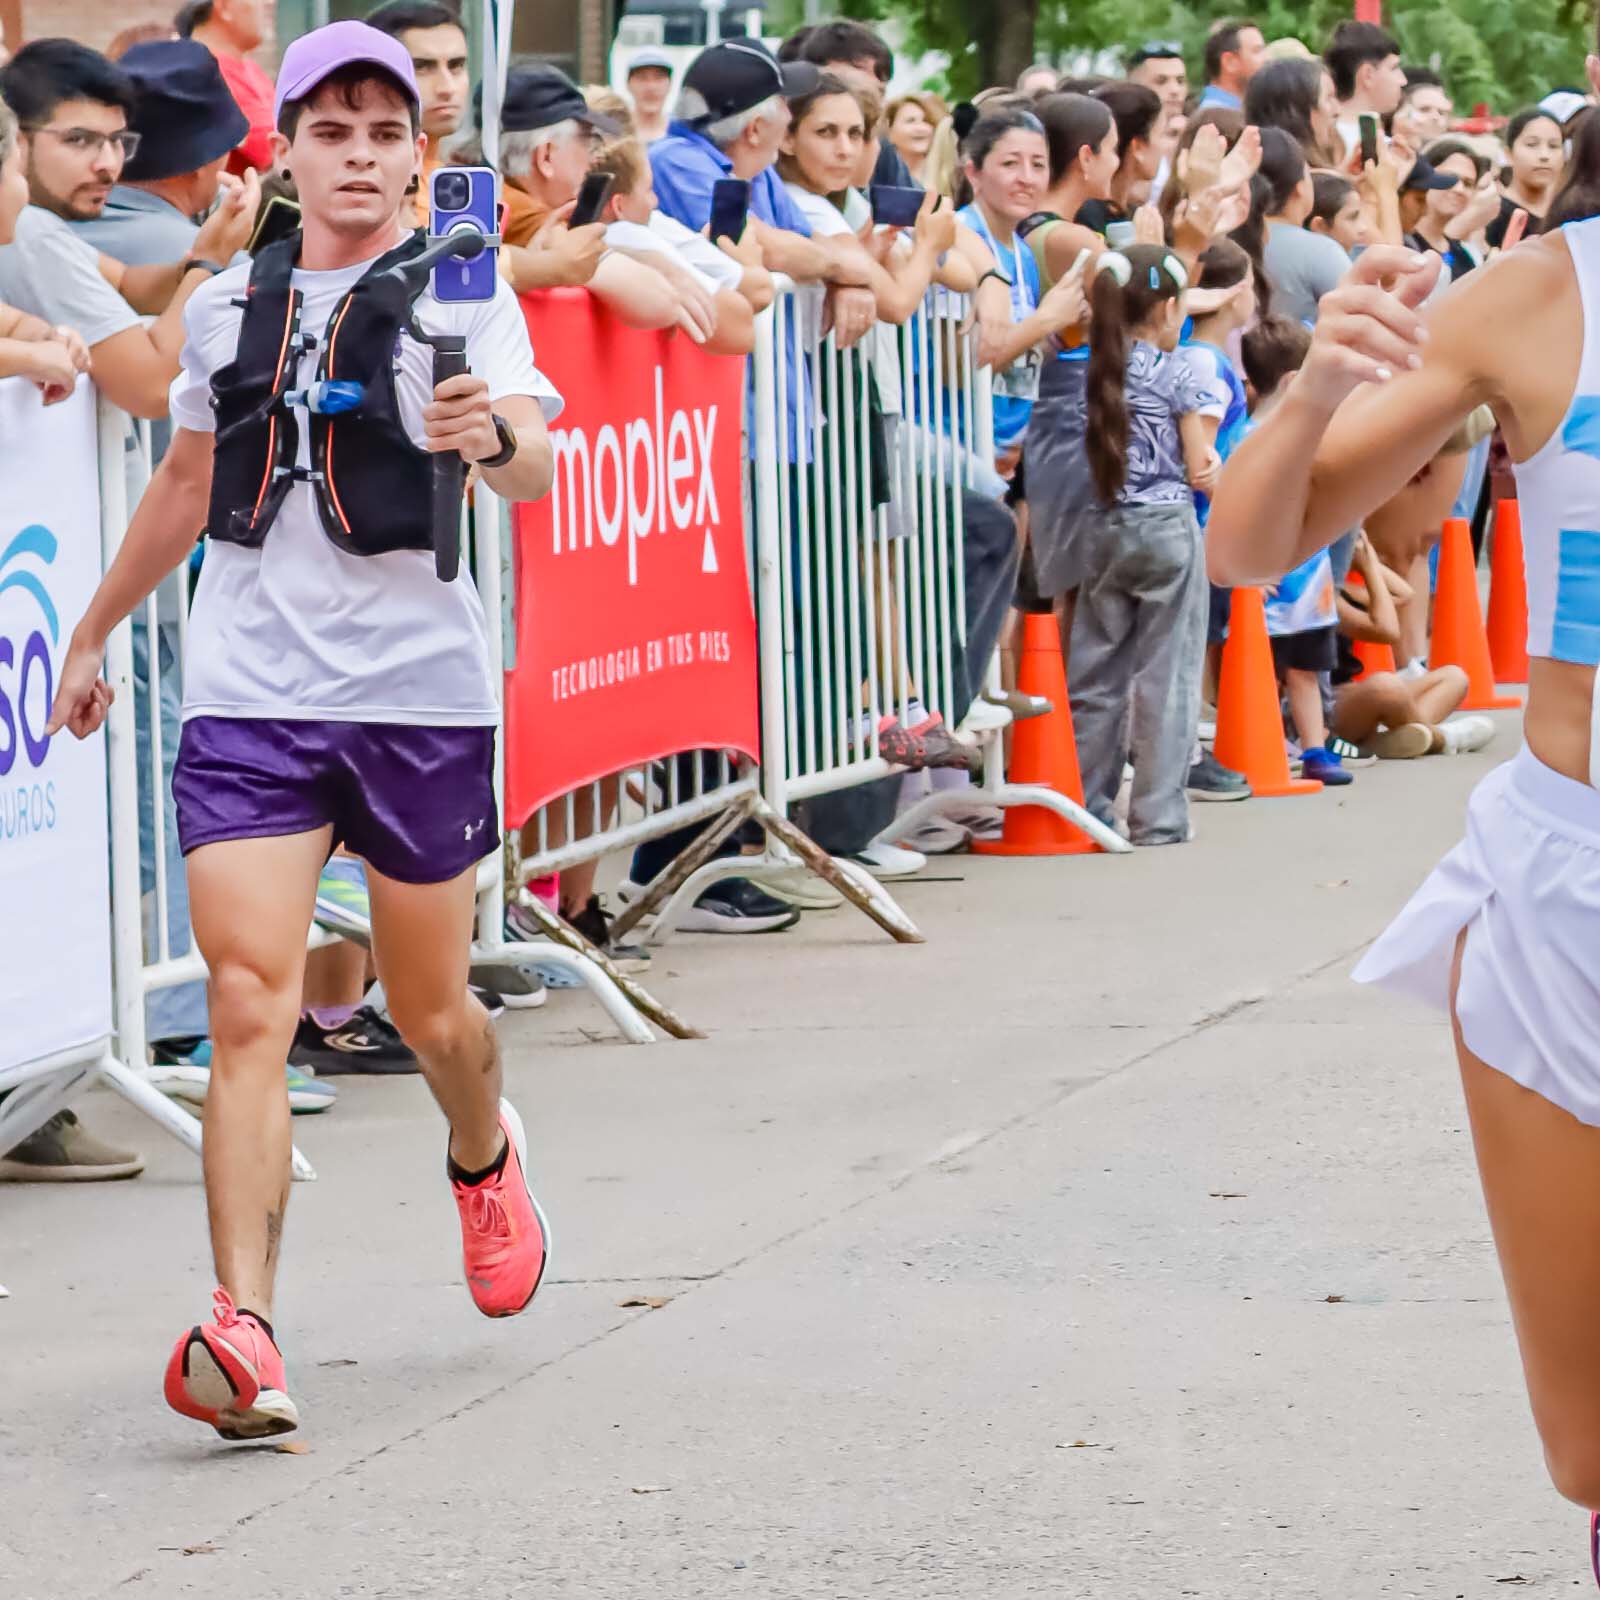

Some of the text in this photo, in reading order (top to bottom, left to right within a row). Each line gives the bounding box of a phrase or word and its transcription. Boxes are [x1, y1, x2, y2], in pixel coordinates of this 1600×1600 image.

[546, 365, 721, 587] moplex
[551, 630, 731, 703] TECNOLOGIA EN TUS PIES
